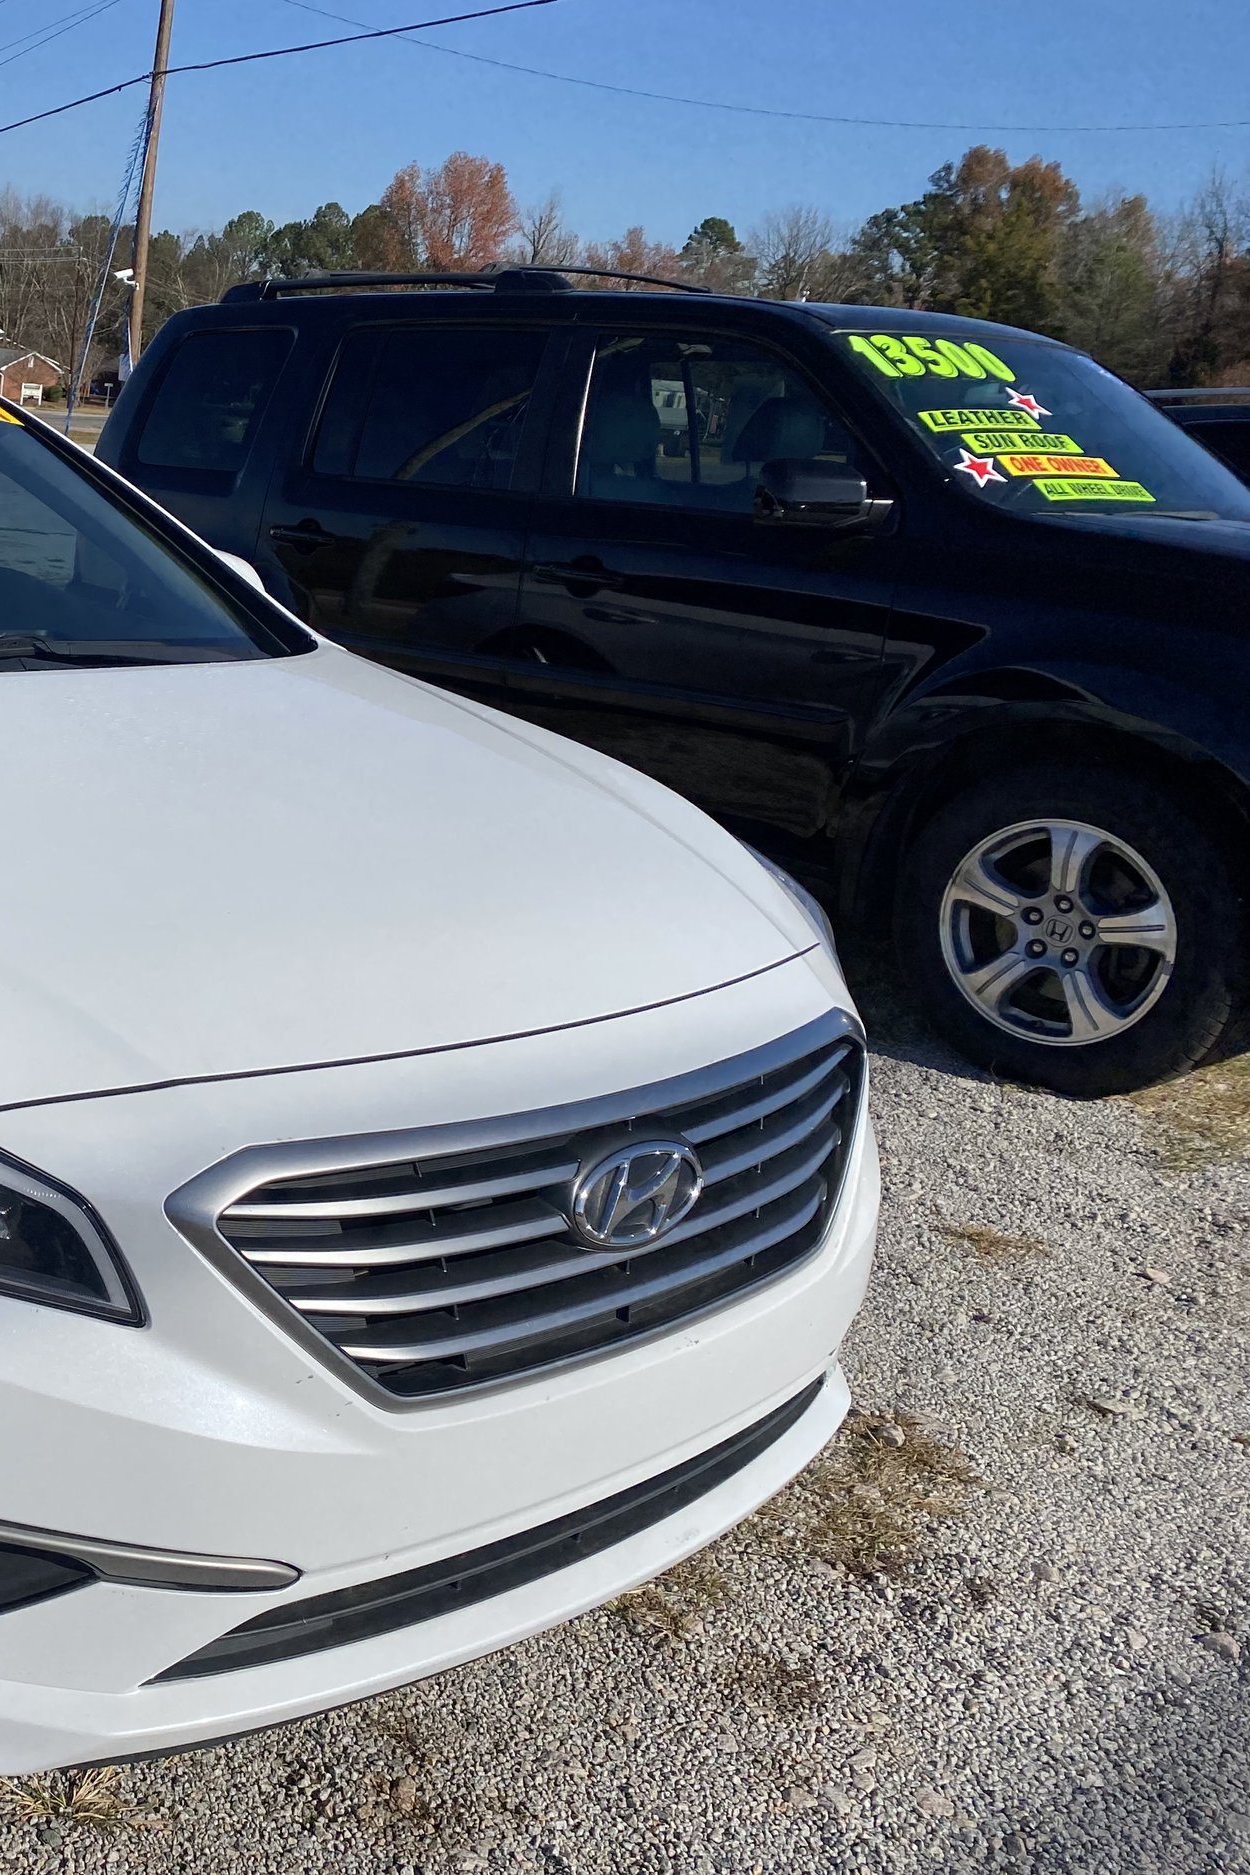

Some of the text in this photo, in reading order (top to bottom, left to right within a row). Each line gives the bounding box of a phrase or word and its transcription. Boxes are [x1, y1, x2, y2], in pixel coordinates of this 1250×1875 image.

[848, 334, 1017, 382] 13500
[928, 410, 1030, 428] LEATHER
[973, 433, 1071, 450] SUN ROOF
[1009, 456, 1110, 474] ONE OWNER
[1043, 482, 1068, 496] ALL
[1066, 482, 1111, 497] WHEEL
